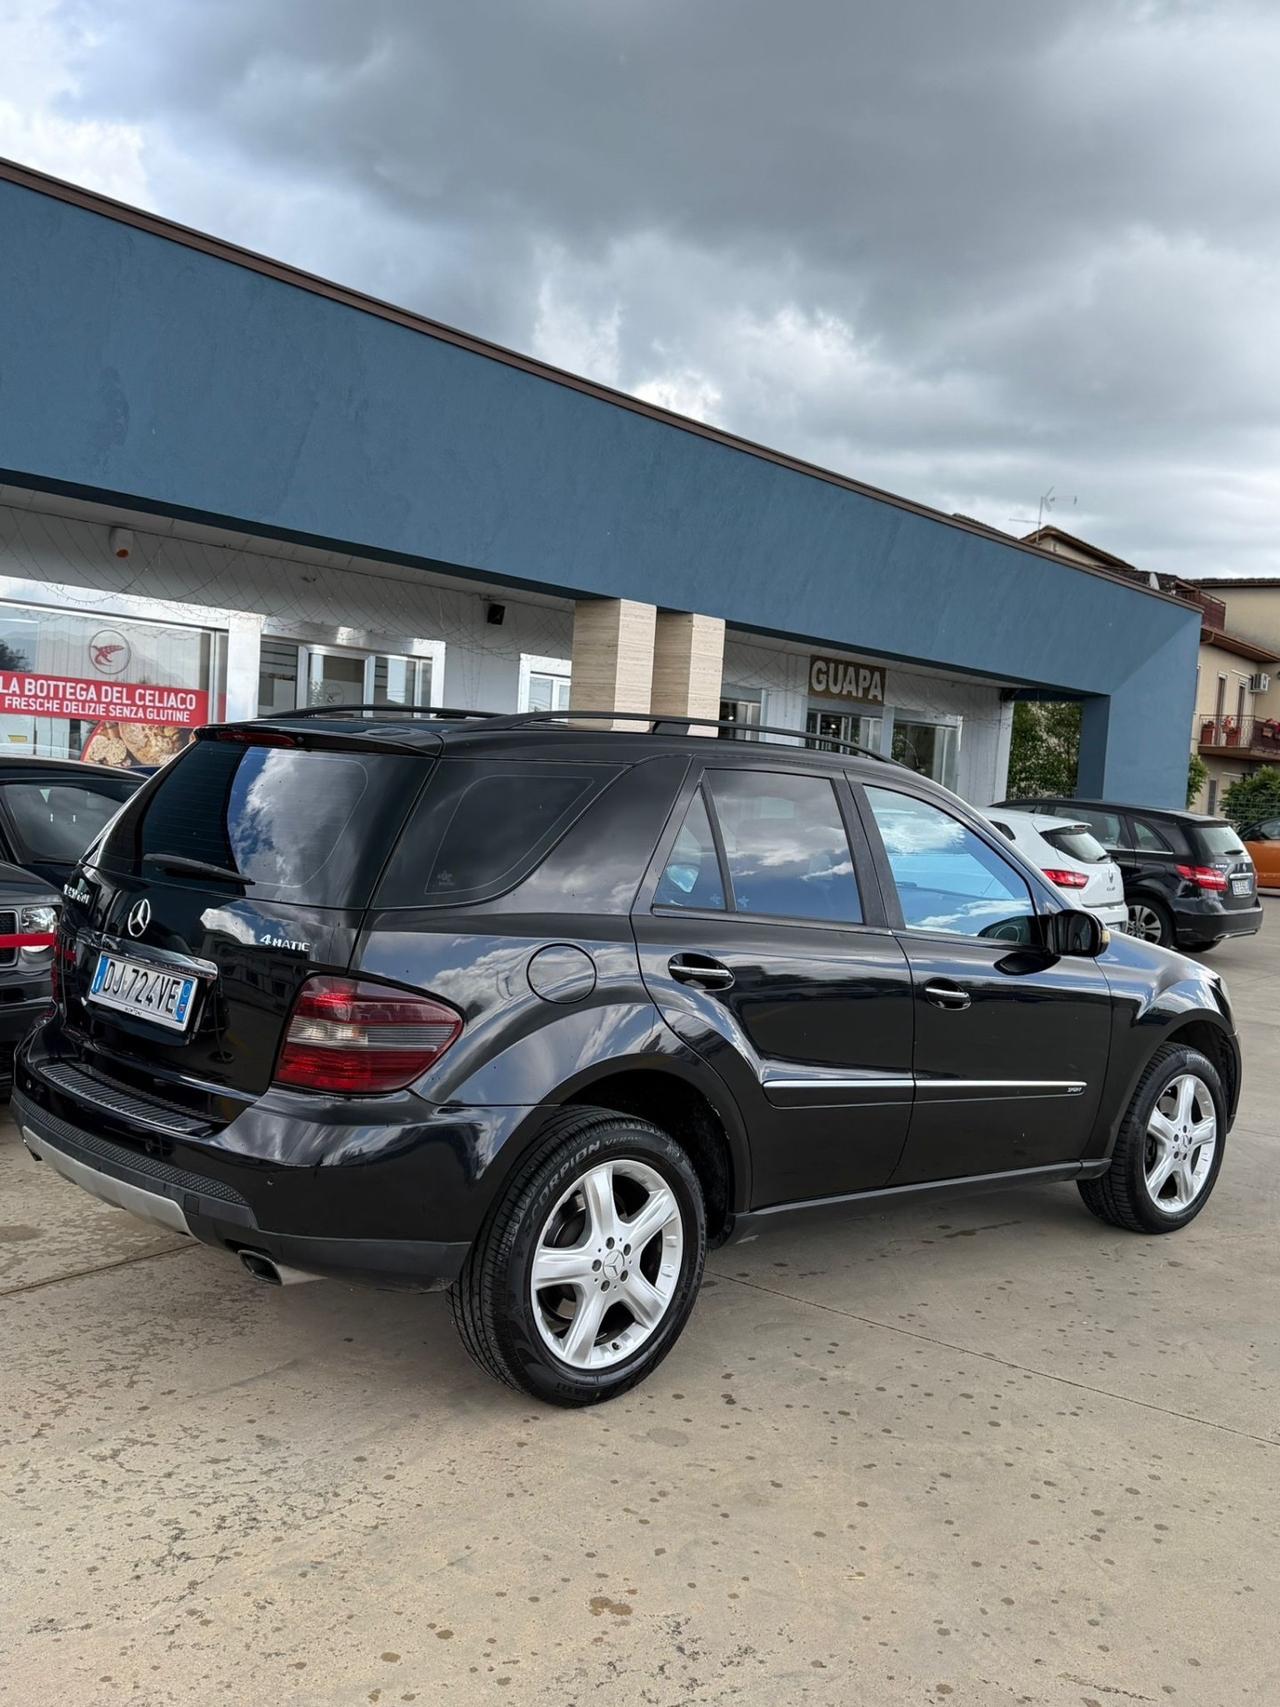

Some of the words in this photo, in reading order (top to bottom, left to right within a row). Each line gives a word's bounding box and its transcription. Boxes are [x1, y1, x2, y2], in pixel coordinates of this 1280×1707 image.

[0, 675, 20, 694] LA
[24, 678, 98, 701] BOTTEGA
[101, 685, 131, 704] DEL
[135, 688, 196, 710] CELIACO
[811, 660, 883, 701] GUAPA
[5, 695, 60, 712] FRESCHE
[63, 700, 107, 716] DELIZIE
[108, 704, 145, 719] SENZA
[146, 707, 190, 723] GLUTINE
